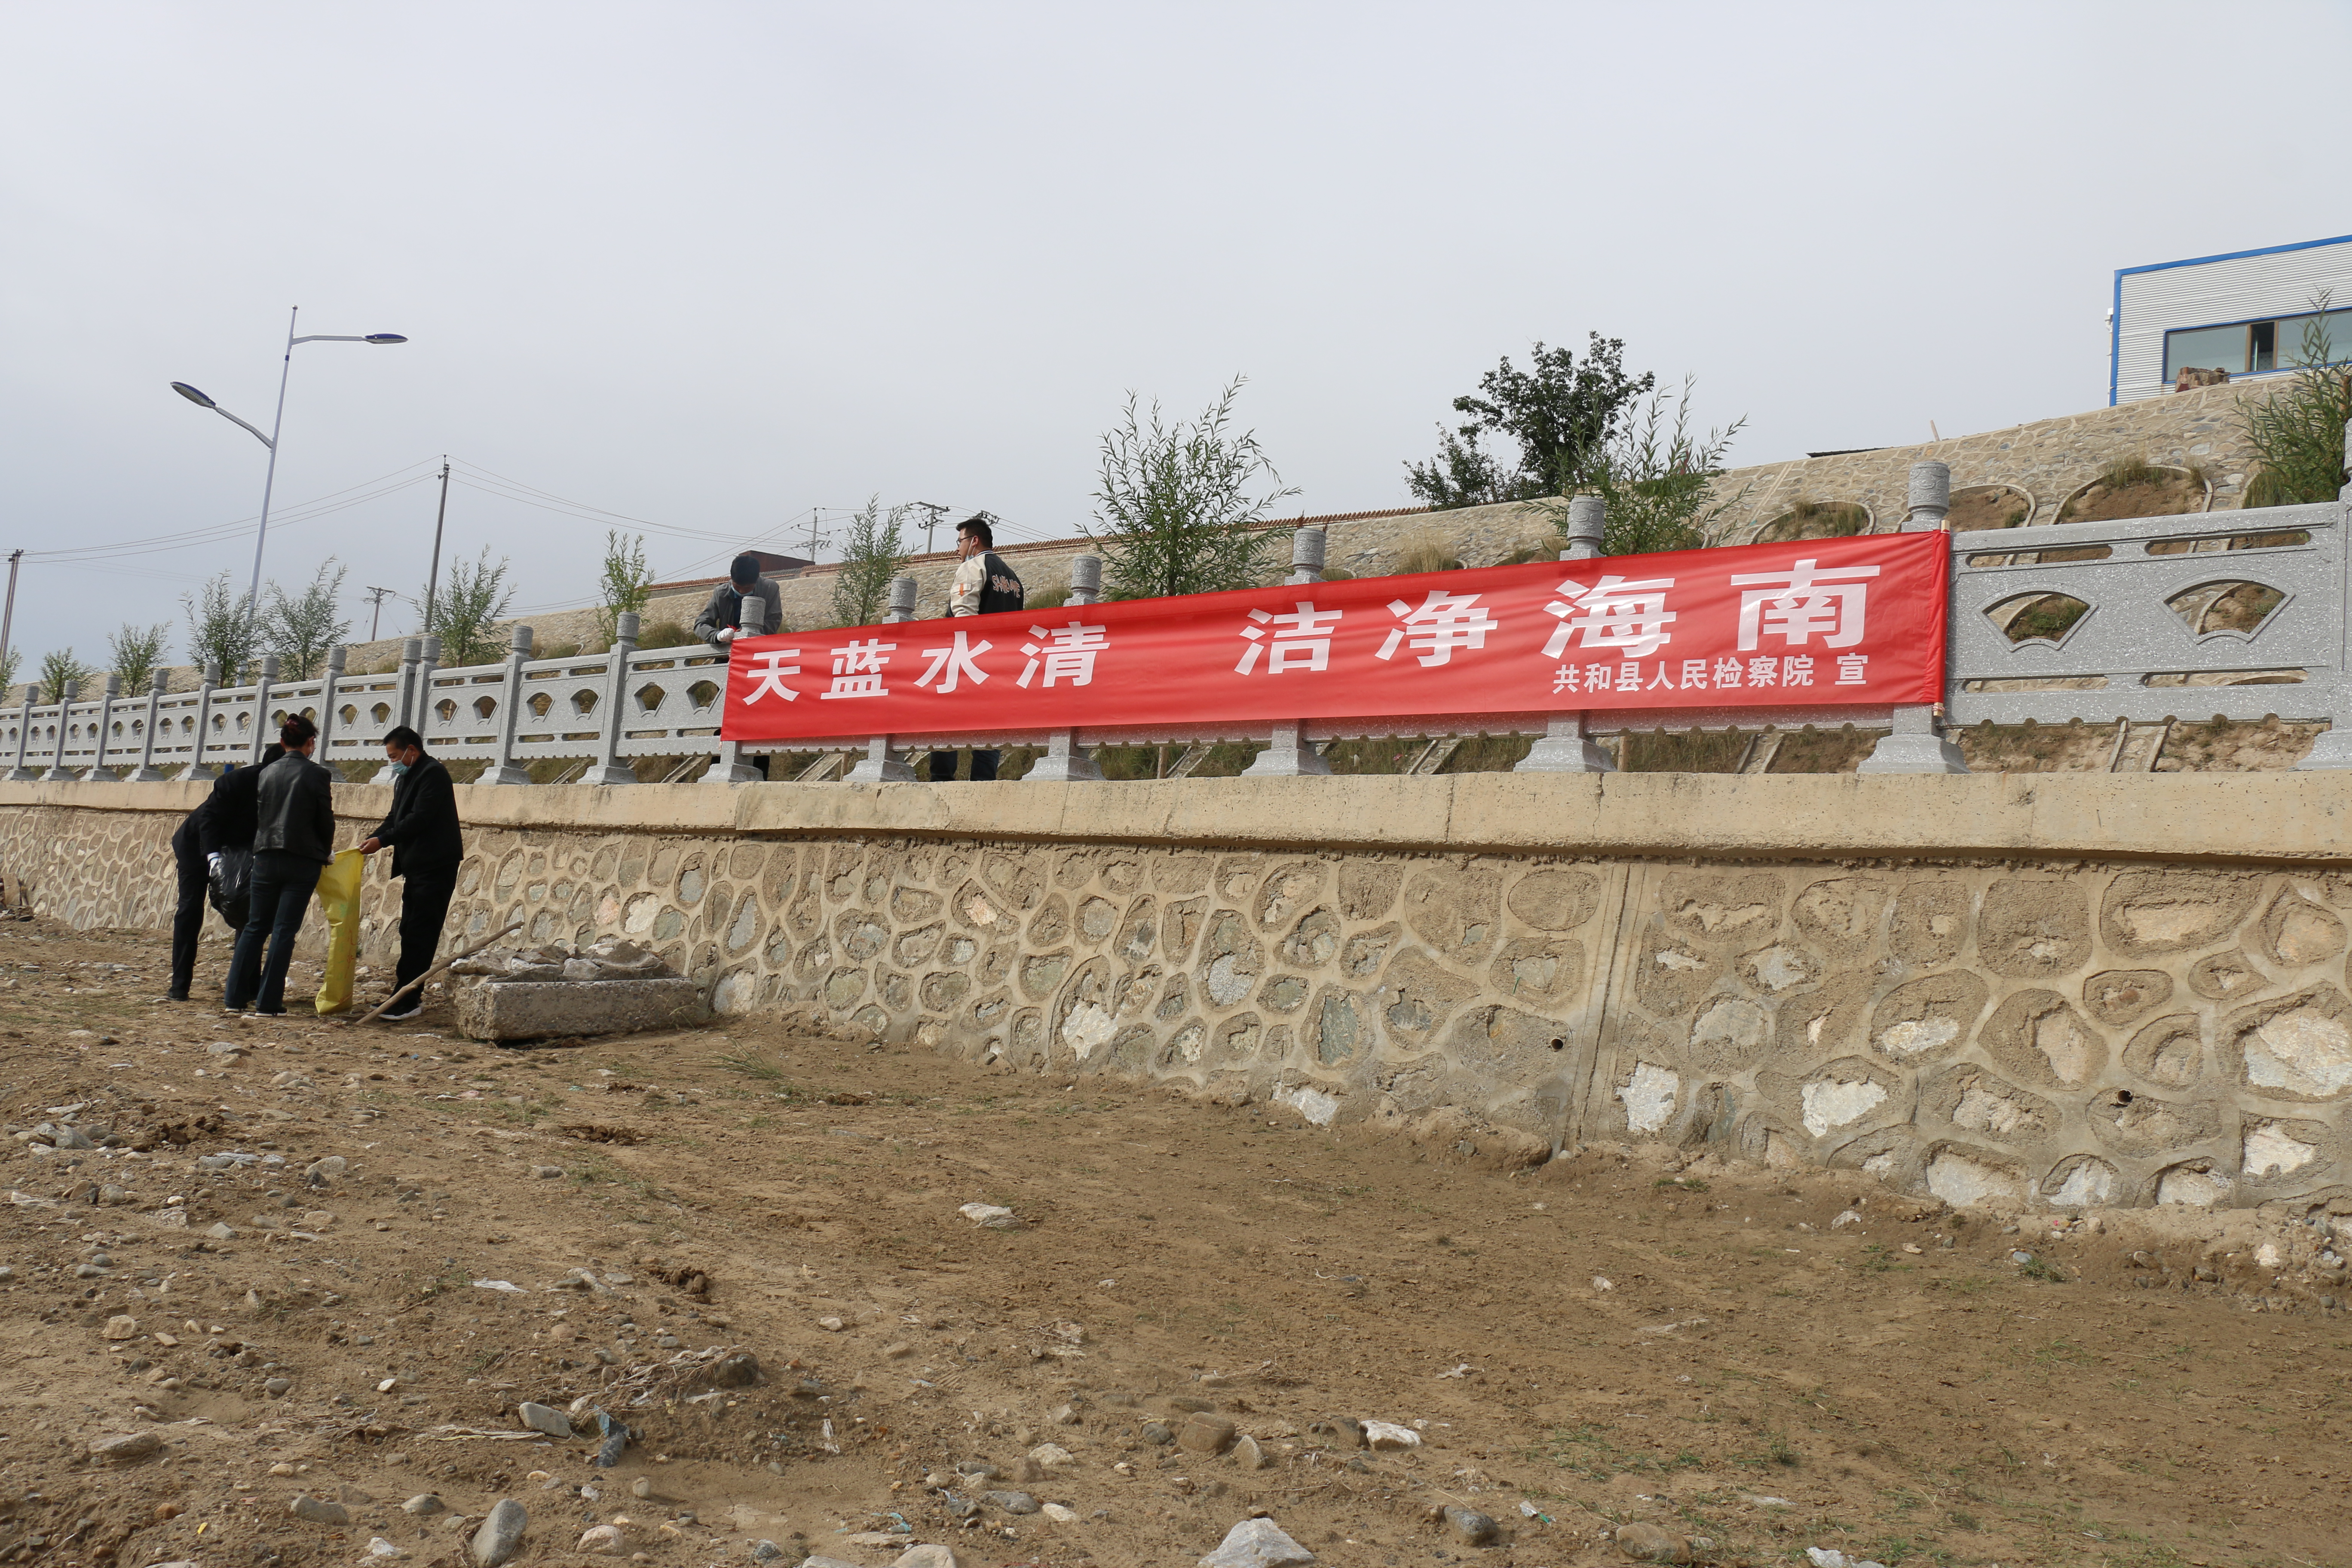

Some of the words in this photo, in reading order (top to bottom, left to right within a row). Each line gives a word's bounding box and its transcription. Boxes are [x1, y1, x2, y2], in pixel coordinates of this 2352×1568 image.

[742, 620, 1111, 706] 天蓝水清
[1234, 557, 1881, 676] 洁净海南
[1553, 654, 1814, 695] 共和县人民检察院
[1834, 652, 1868, 686] 宣
